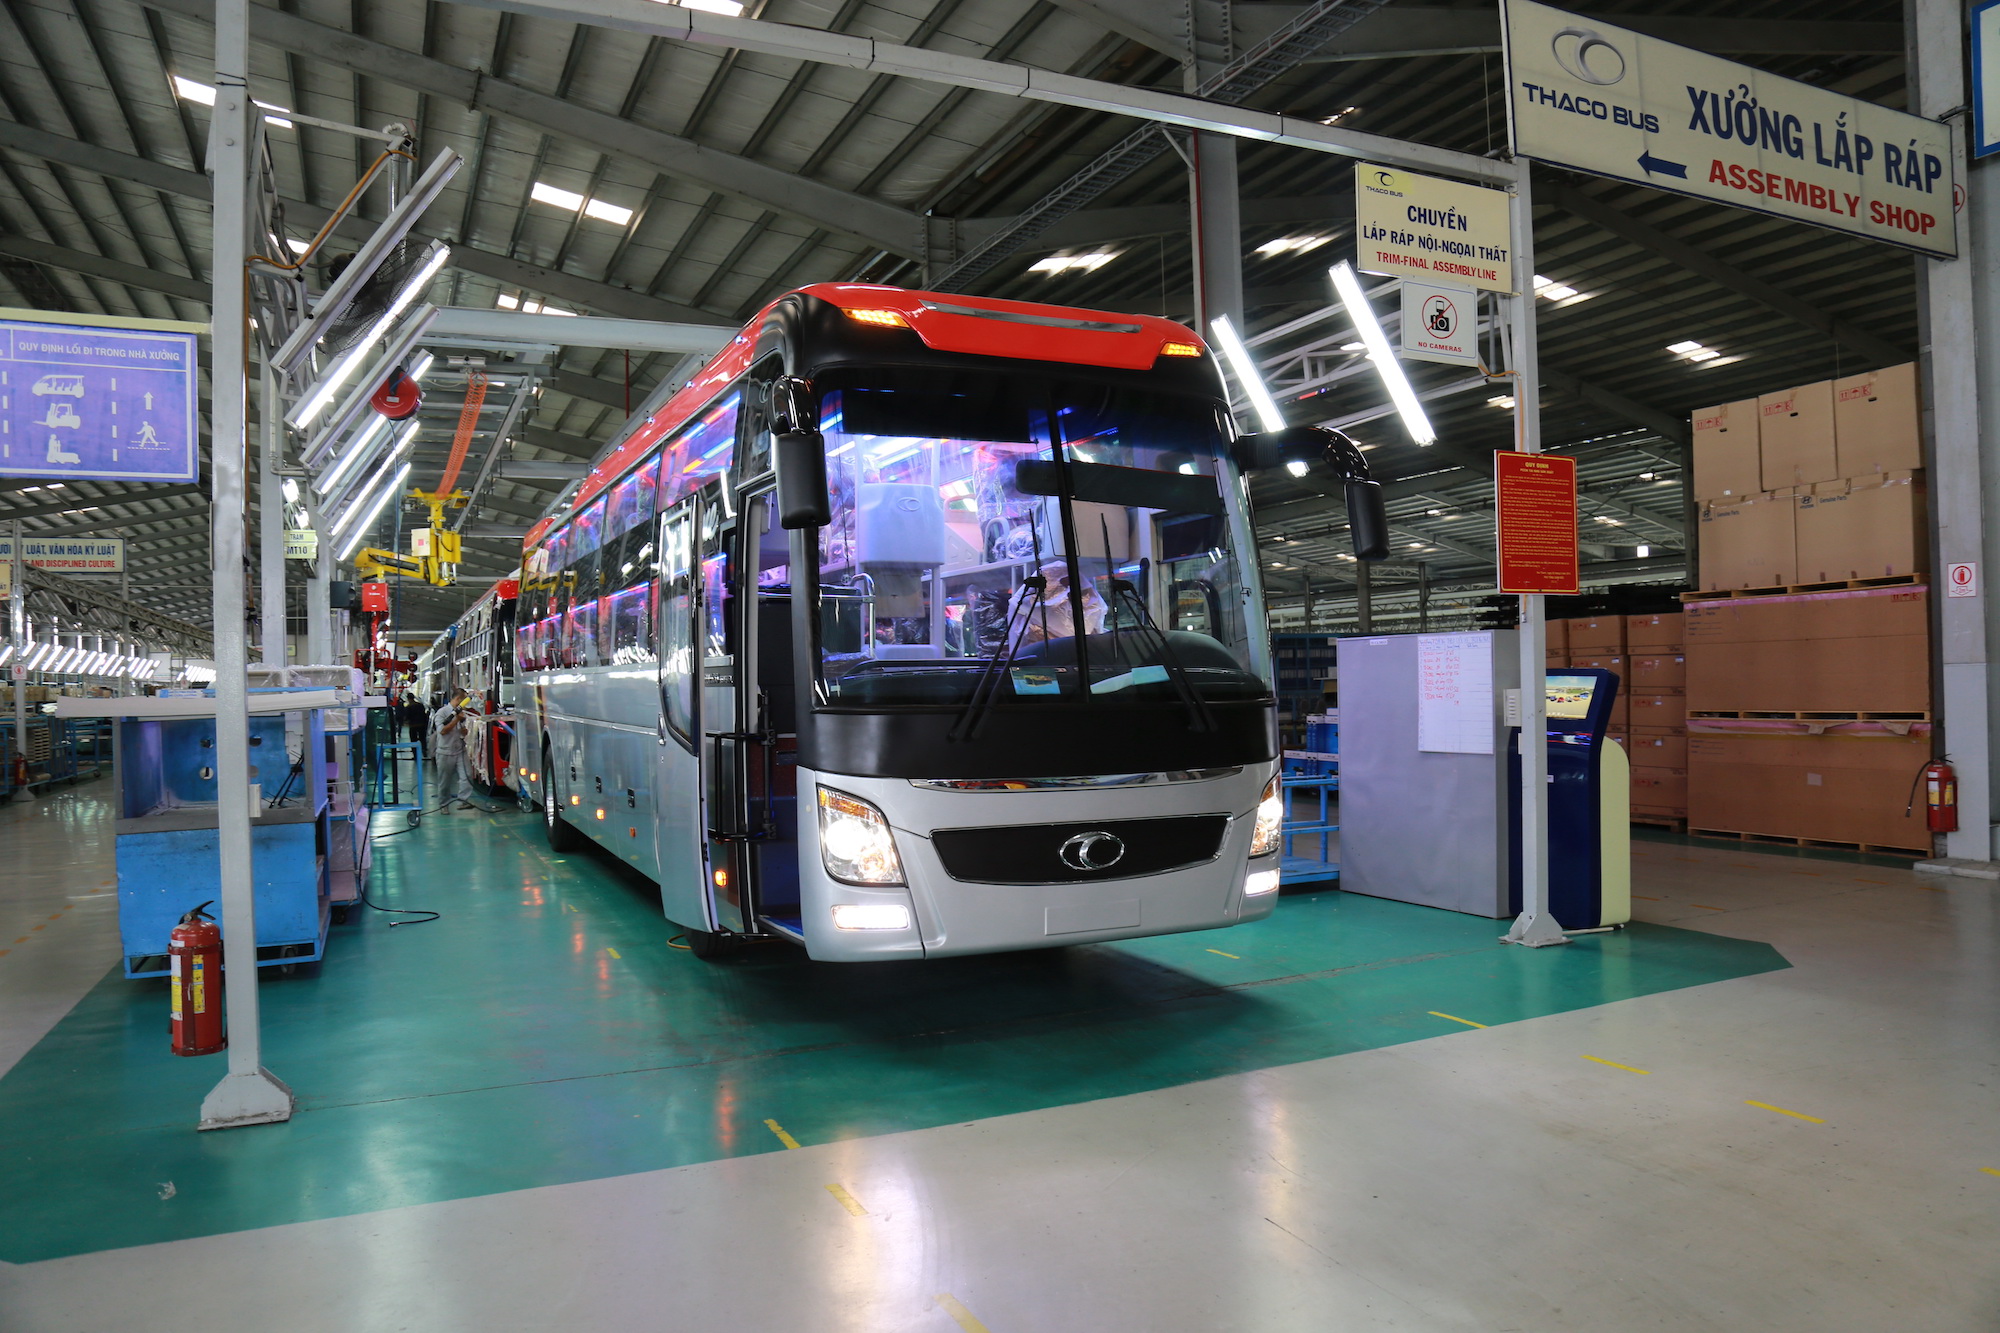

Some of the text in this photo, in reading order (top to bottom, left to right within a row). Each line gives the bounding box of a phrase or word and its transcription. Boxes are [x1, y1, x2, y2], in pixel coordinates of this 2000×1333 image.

[1522, 82, 1660, 134] THACO BUS
[1686, 84, 1942, 194] XƯỞNG LẮP RÁP
[1366, 186, 1403, 198] THACO BUS
[1708, 159, 1936, 236] ASSEMBLY SHOP
[1407, 205, 1467, 232] CHUYỀN
[1363, 221, 1387, 241] LẮP
[1390, 229, 1414, 246] RÁP
[1478, 244, 1507, 263] THẤT
[1376, 251, 1497, 281] TRIM-FINAL ASSEMBLY LINE
[18, 342, 180, 361] QUY ĐỊNH LỐI ĐI TRONG NHÀ XƯỞNG
[1429, 342, 1462, 353] CAMERAS
[49, 542, 65, 555] VĂN
[67, 542, 83, 555] HÓA
[97, 543, 116, 557] LUẬT
[287, 546, 308, 554] MT10
[46, 559, 87, 568] DISCIPLINED
[88, 560, 116, 568] CULTURE
